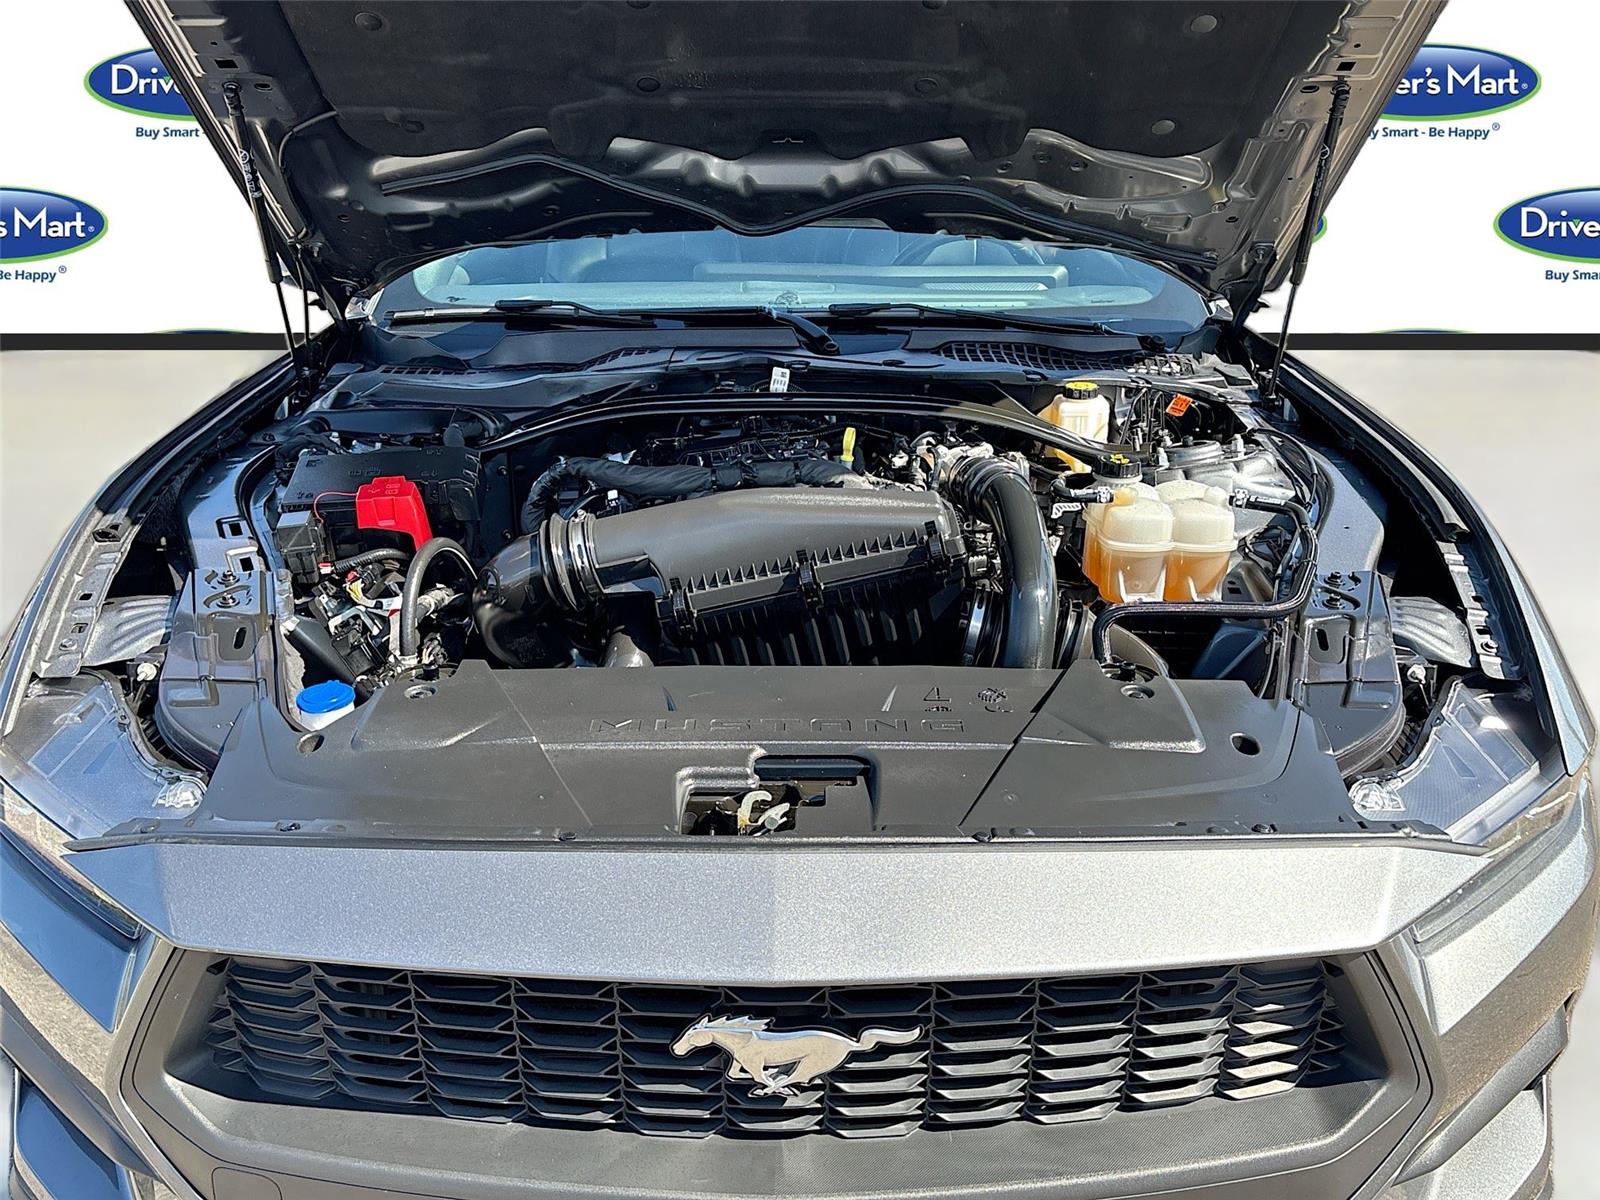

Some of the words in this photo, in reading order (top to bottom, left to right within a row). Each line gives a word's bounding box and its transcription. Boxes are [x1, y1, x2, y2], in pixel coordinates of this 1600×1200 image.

[1447, 64, 1519, 94] Mart
[136, 127, 160, 140] Buy
[163, 127, 200, 138] Smart
[1382, 126, 1419, 137] Smart
[1428, 127, 1445, 137] Be
[1448, 127, 1490, 139] Happy
[14, 206, 86, 237] Mart
[15, 270, 57, 283] Happy
[1545, 269, 1569, 283] Buy
[1572, 269, 1600, 280] Sma
[589, 718, 965, 733] MUSTANG
